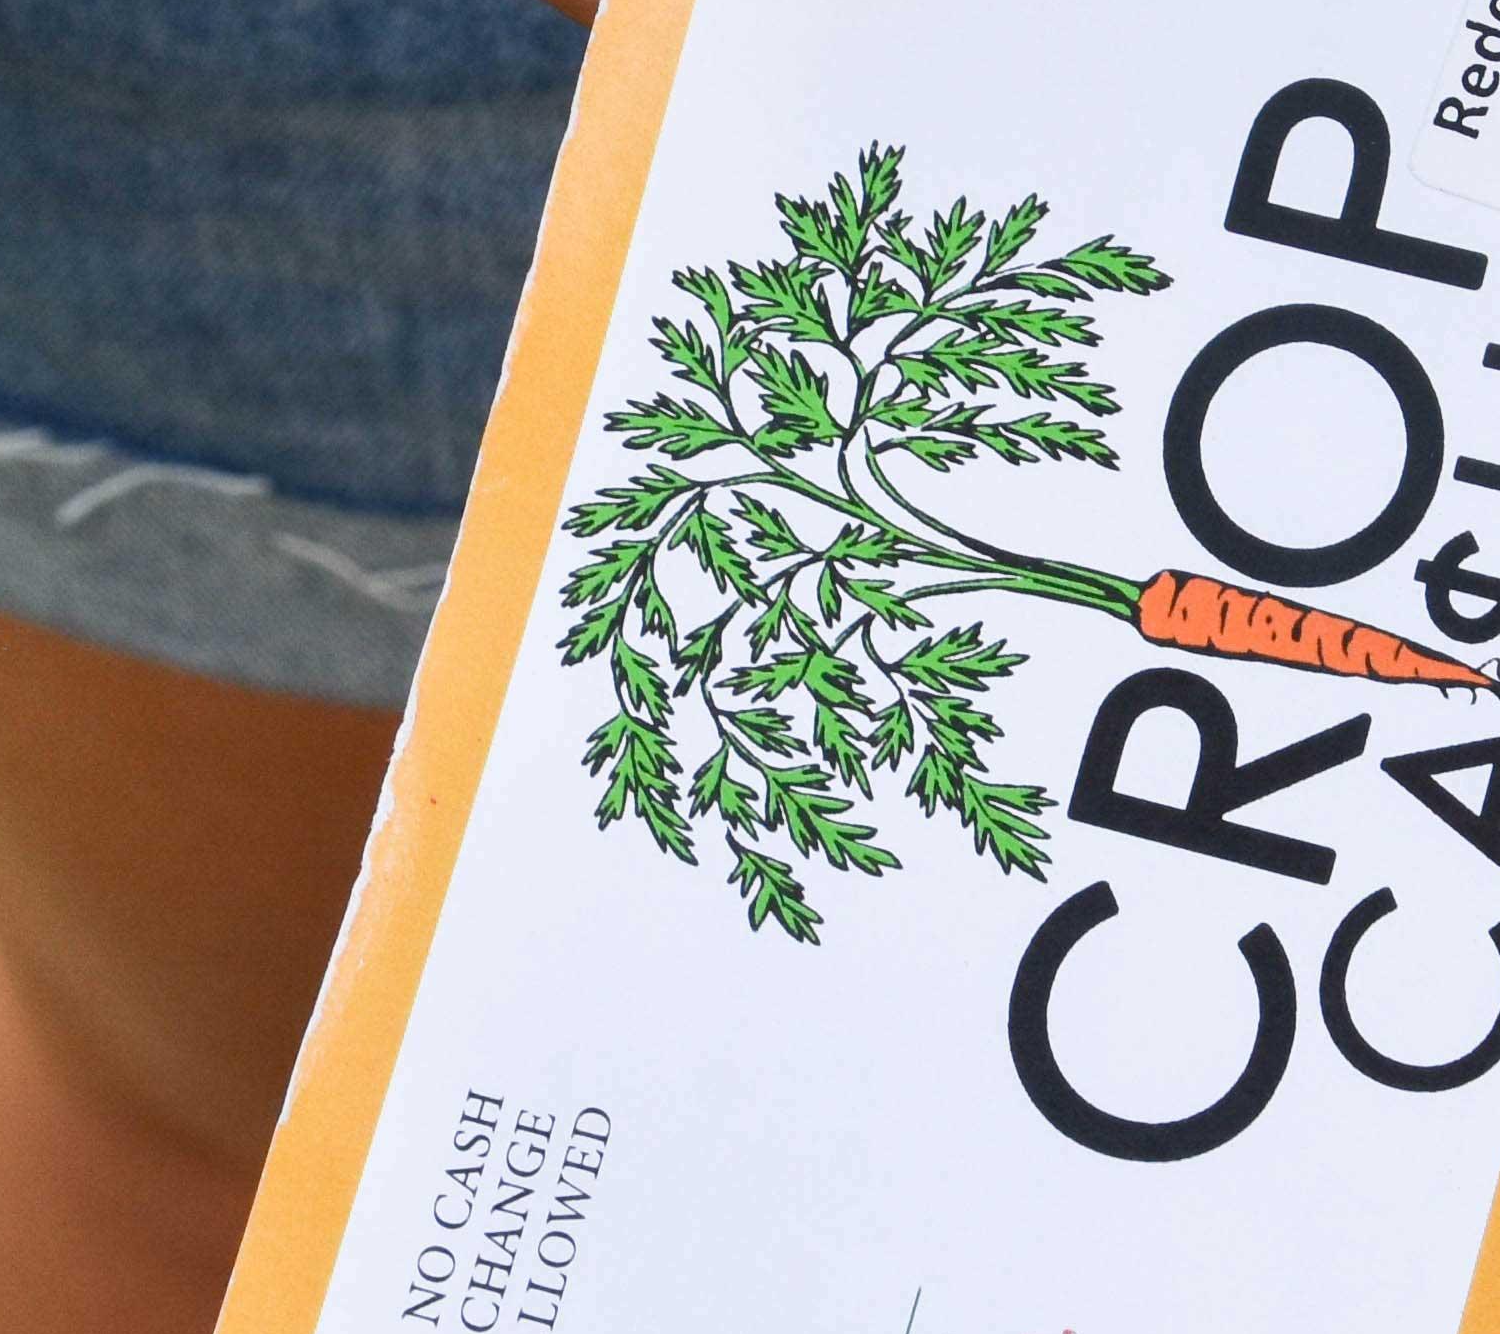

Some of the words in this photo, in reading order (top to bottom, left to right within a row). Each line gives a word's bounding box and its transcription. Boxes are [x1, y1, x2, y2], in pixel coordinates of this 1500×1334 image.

[1005, 75, 1490, 1164] CROP
[401, 1245, 456, 1328] NO
[433, 1087, 505, 1231] CASH
[460, 1108, 556, 1334] CHANGE
